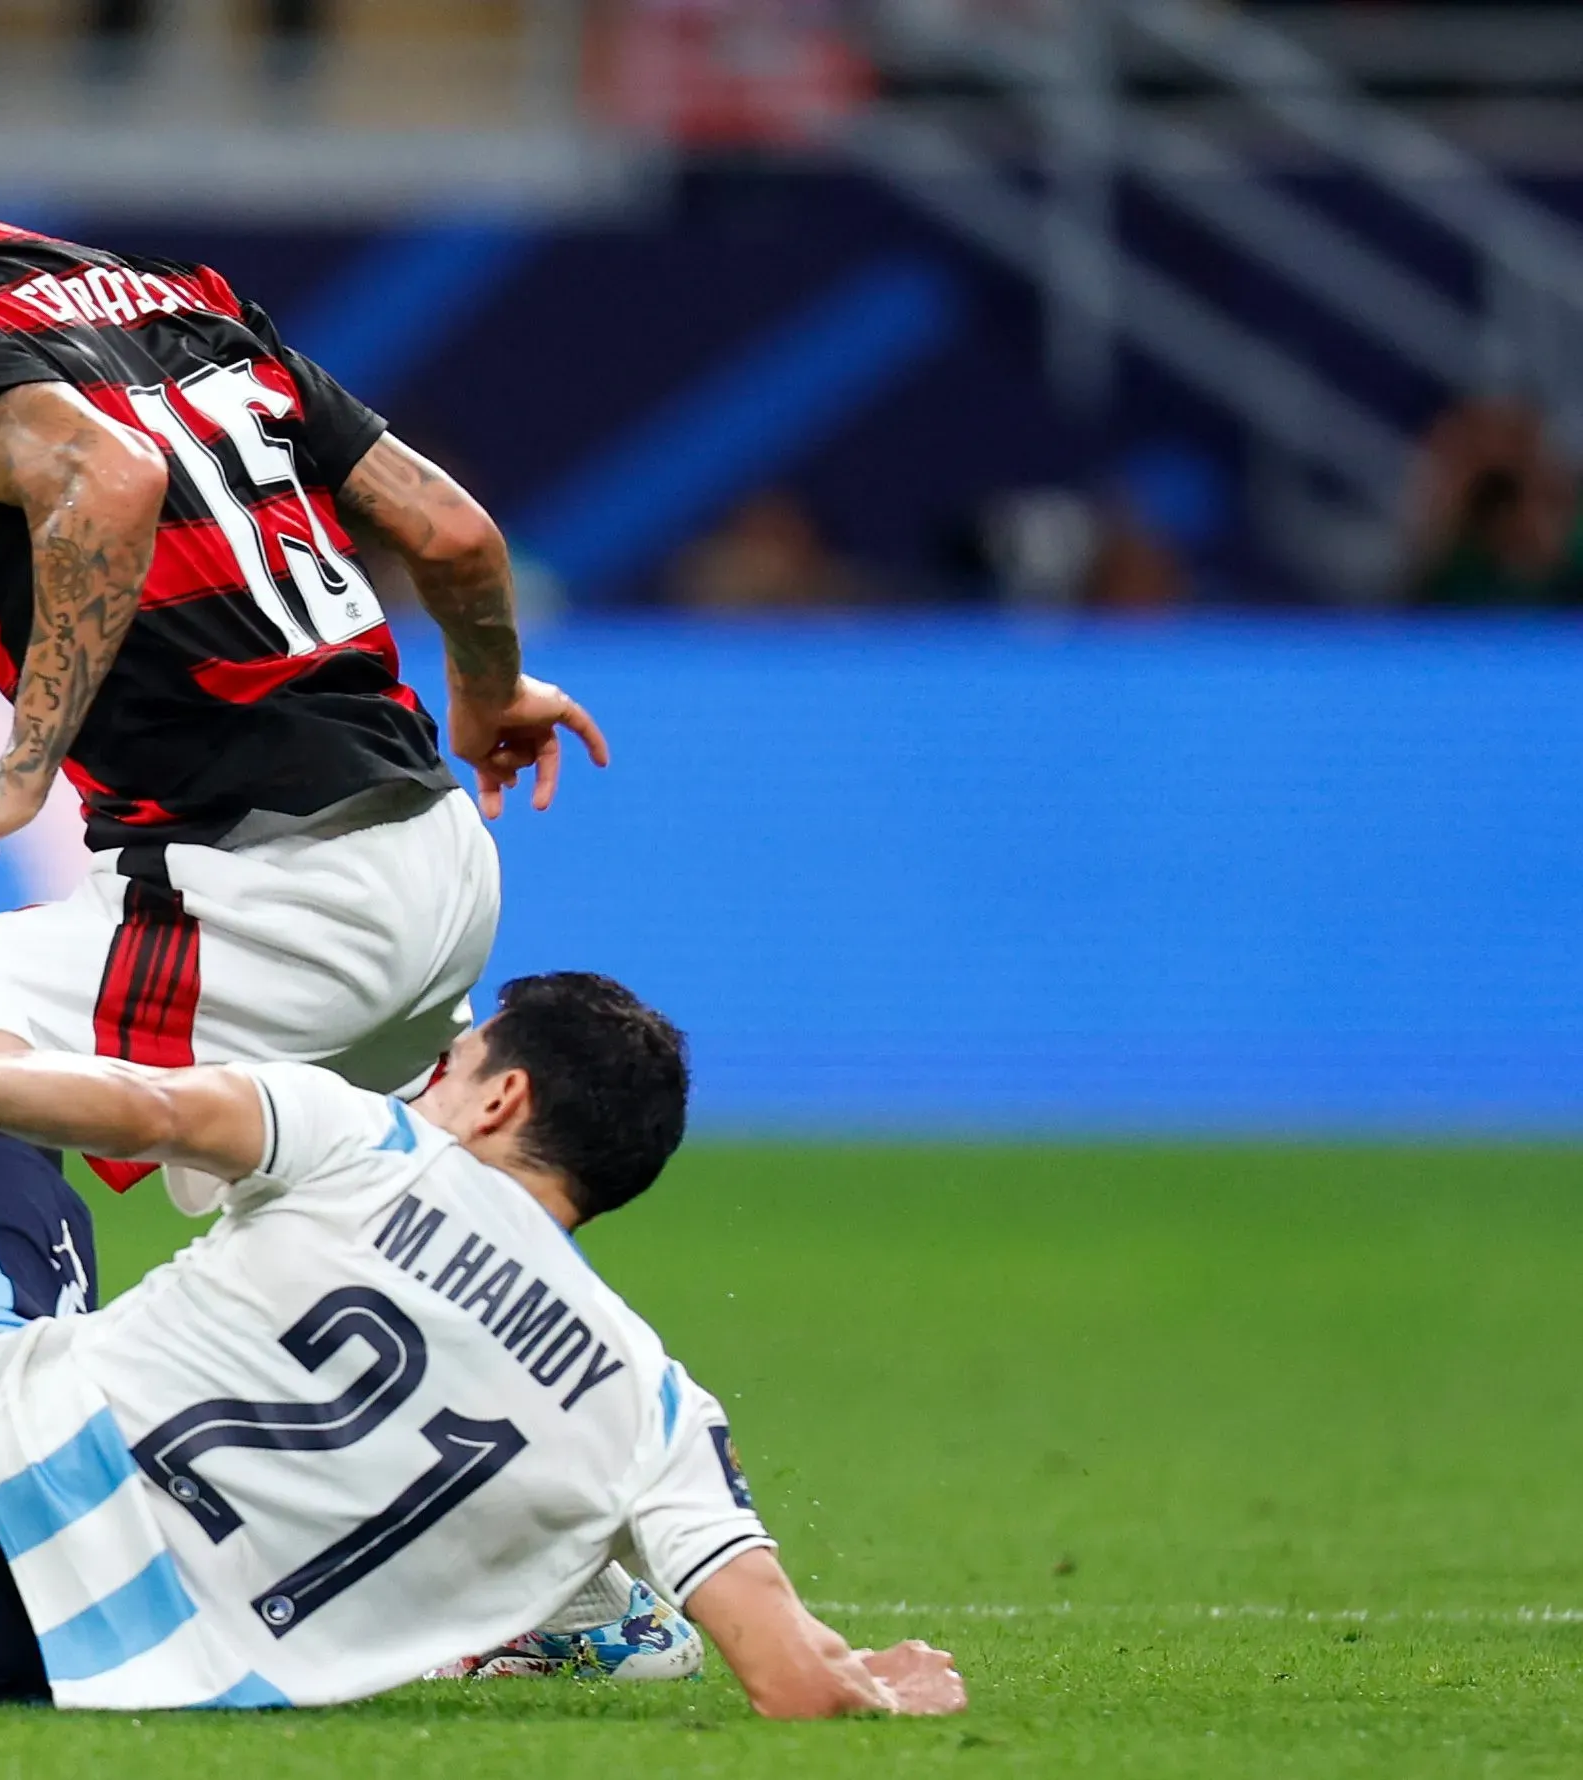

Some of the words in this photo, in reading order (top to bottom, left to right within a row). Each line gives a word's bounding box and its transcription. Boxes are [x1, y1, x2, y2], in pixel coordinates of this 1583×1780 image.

[126, 359, 386, 657] 15
[373, 1194, 624, 1412] M.HAMDY
[130, 1286, 530, 1640] 21
